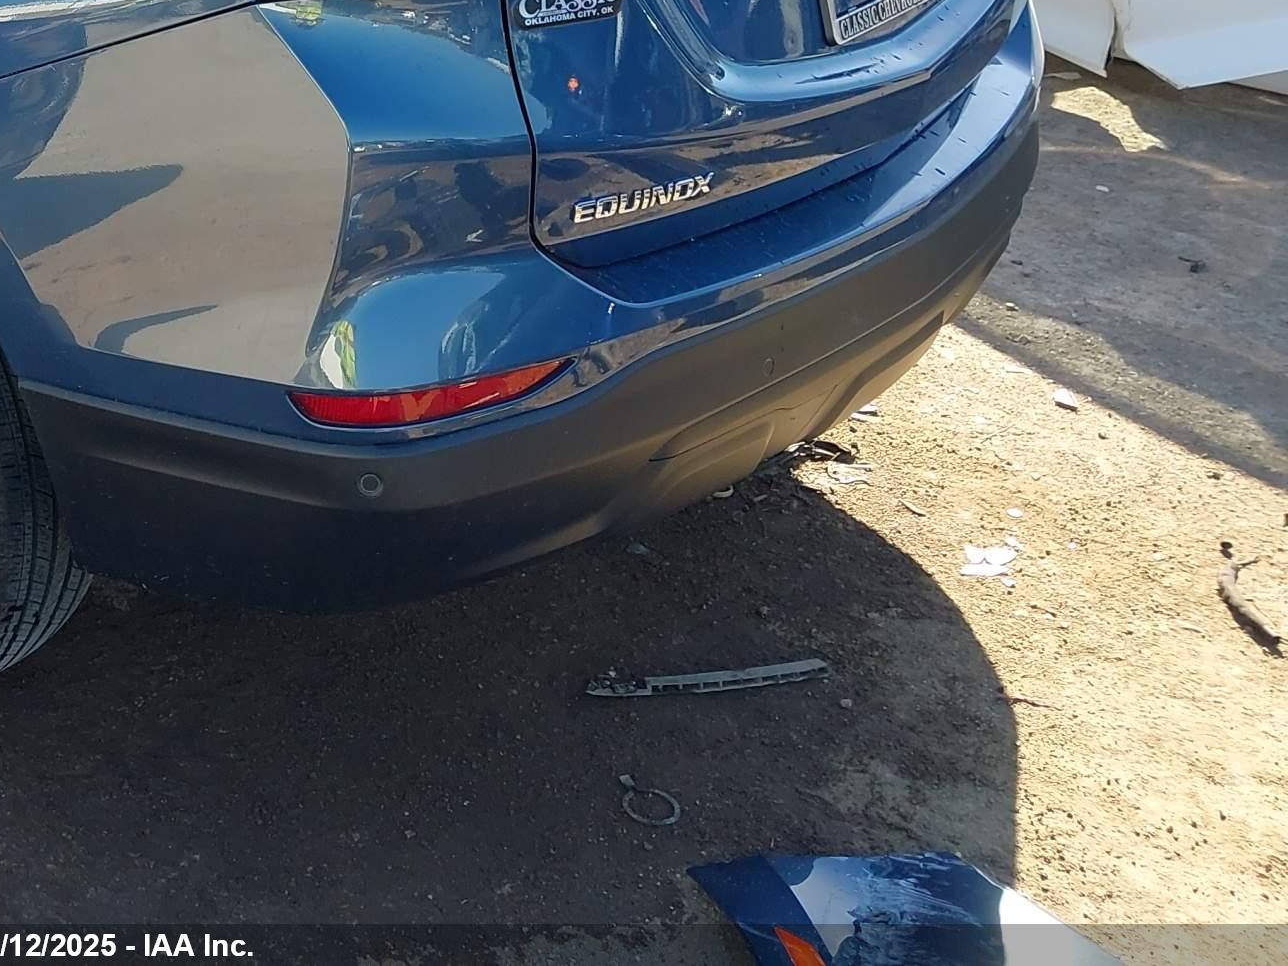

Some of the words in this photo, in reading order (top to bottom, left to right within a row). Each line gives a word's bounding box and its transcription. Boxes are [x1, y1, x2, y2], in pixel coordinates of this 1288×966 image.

[524, 12, 576, 27] OKLAHOMA
[601, 5, 614, 15] OK
[840, 6, 879, 39] CLASSIC
[574, 171, 715, 224] EQUINOX
